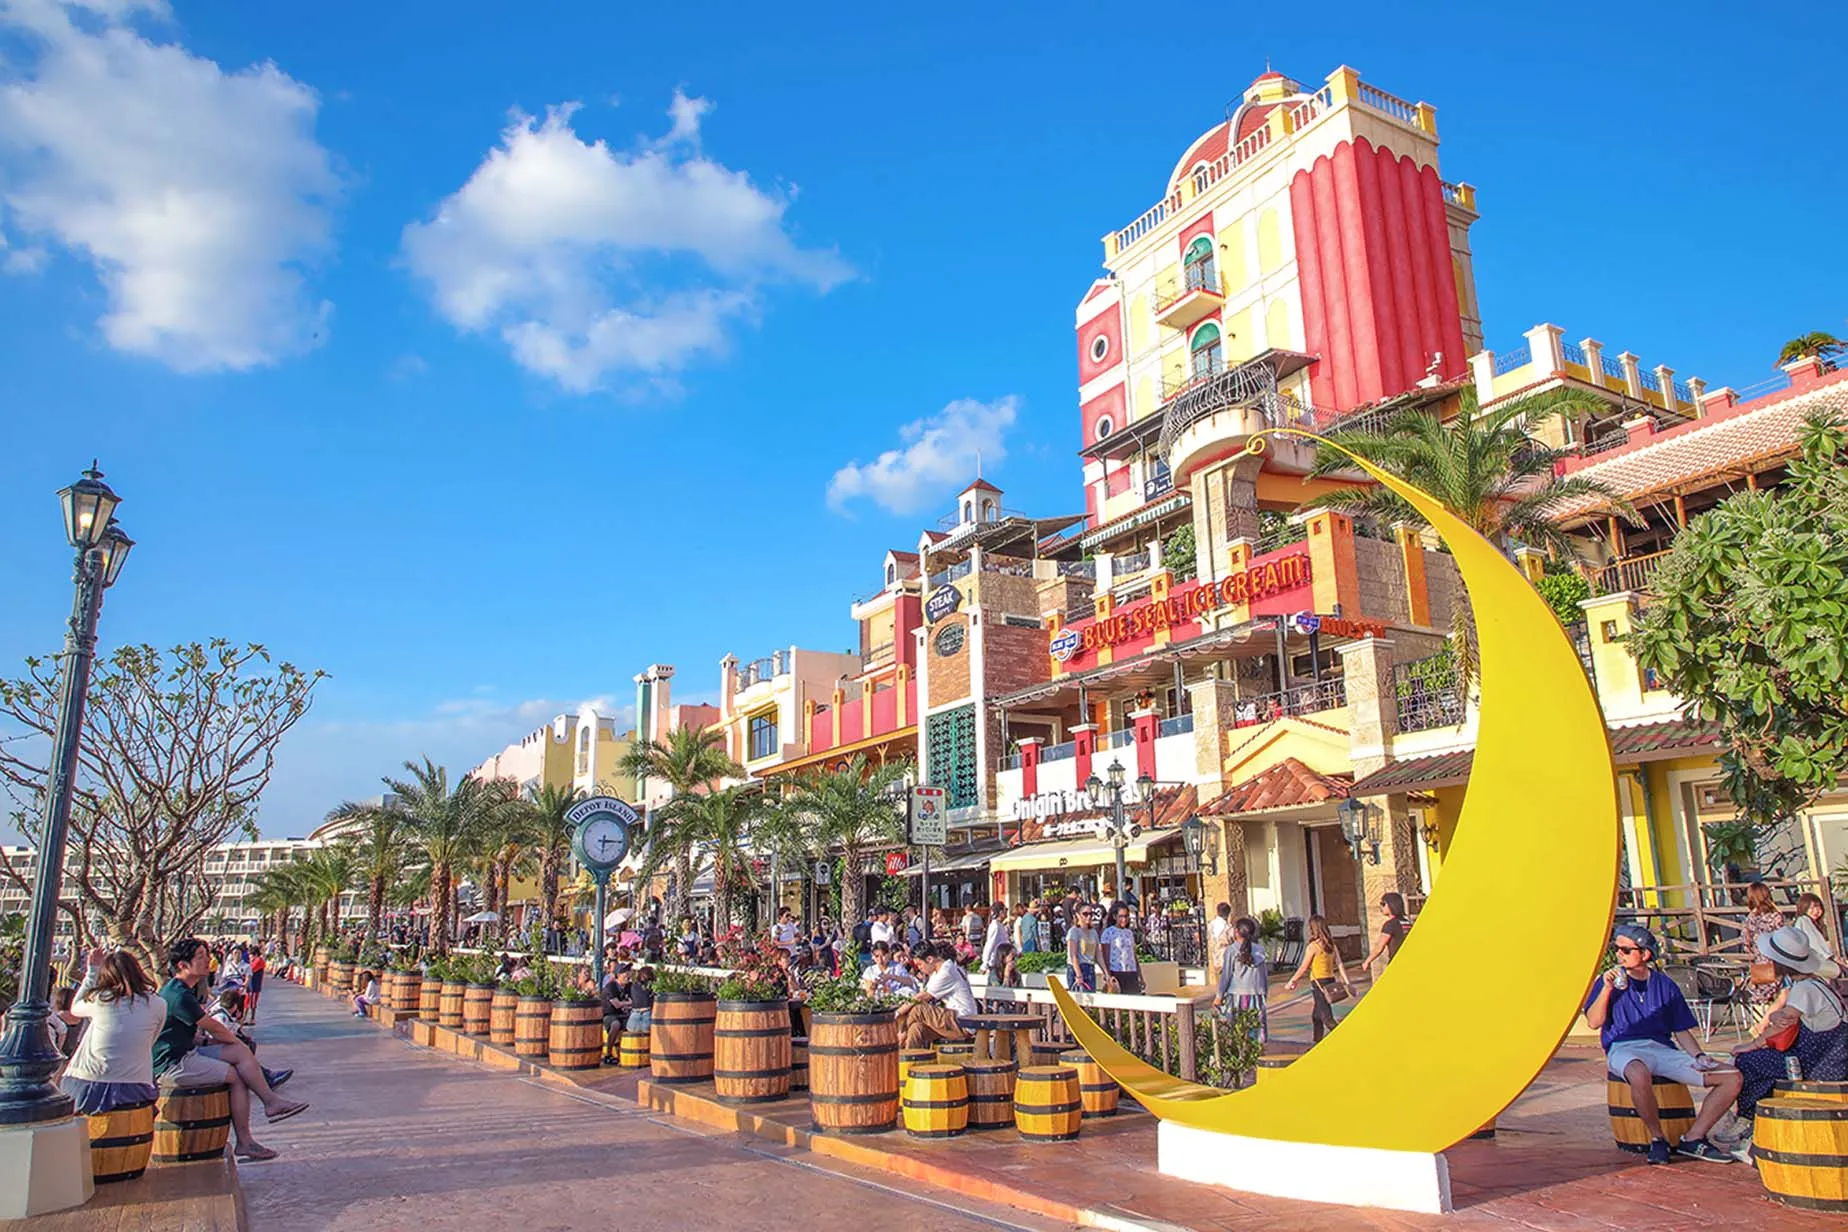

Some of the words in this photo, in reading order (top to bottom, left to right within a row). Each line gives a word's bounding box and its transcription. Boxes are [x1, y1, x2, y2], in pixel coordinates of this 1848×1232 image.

[929, 591, 954, 612] STEAK
[1084, 612, 1128, 650] BLUE
[1131, 597, 1178, 634] SEAL
[1183, 582, 1217, 617] ICE
[1221, 554, 1304, 603] CREAM
[572, 801, 602, 821] DEPOT
[604, 801, 634, 824] ISLAND
[888, 855, 906, 871] illy
